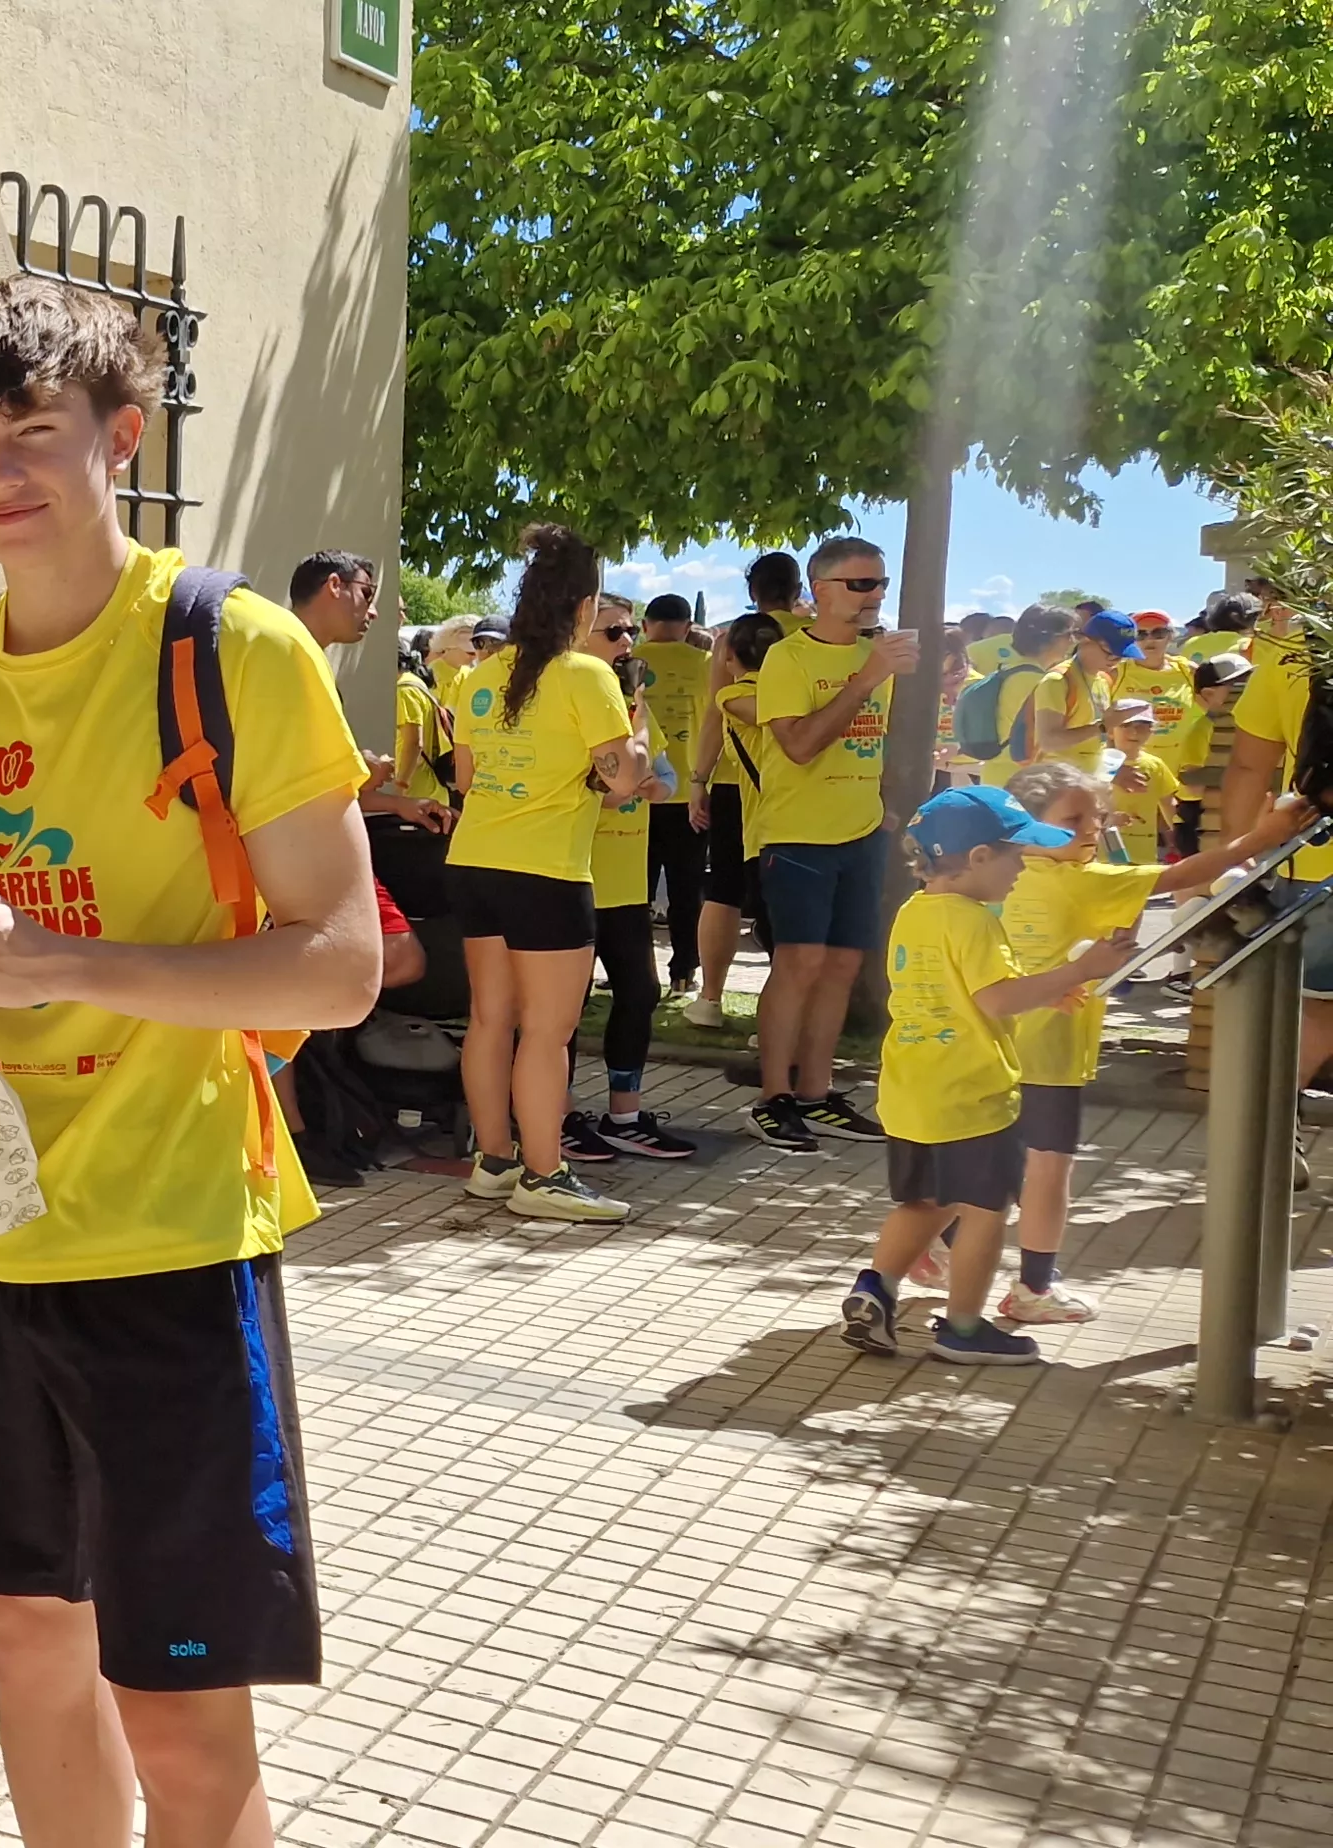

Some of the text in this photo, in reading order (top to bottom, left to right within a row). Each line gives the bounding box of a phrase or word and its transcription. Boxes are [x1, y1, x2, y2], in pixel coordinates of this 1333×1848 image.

[356, 0, 386, 47] MAYOR
[59, 866, 95, 903] DE
[169, 1639, 207, 1656] soka
